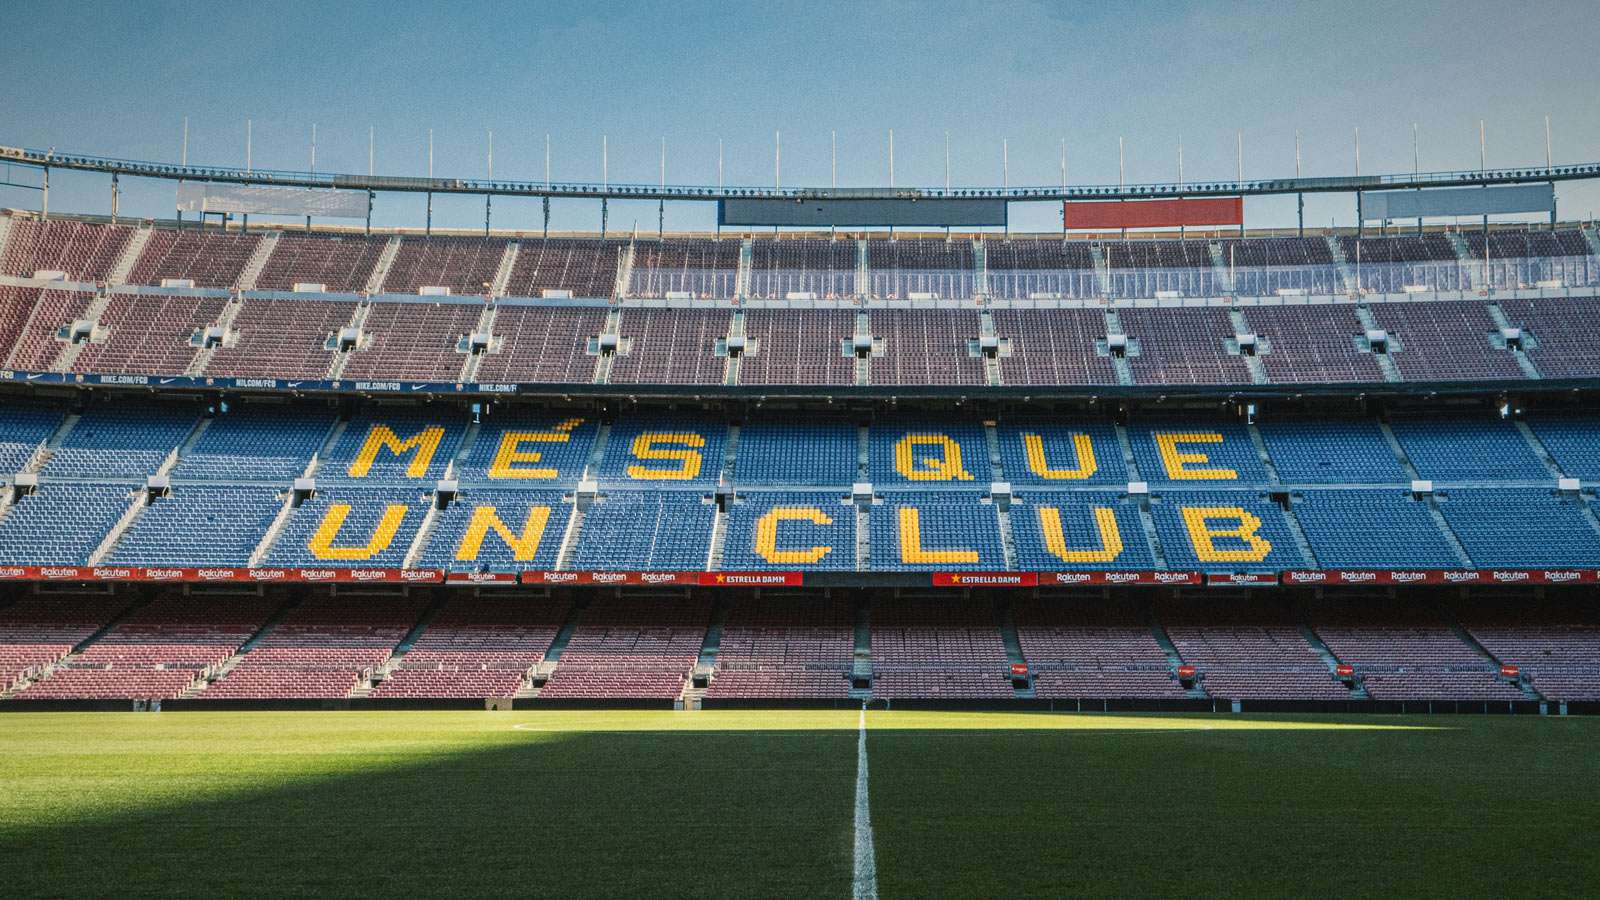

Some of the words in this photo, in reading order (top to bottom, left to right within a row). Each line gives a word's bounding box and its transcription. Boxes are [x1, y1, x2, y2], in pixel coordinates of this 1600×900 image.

[100, 375, 148, 384] NIKE.COM/FCB
[355, 382, 401, 391] NIKE.COM/FCB
[896, 431, 1238, 480] QUE
[307, 504, 552, 562] UN
[755, 506, 1272, 564] CLUB
[41, 568, 77, 576] Rakuten
[93, 568, 129, 577] Rakuten
[146, 569, 182, 578] Rakuten
[198, 569, 233, 578] Rakuten
[249, 570, 284, 578] Rakuten
[301, 570, 336, 578] Rakuten
[351, 570, 386, 578] Rakuten
[401, 570, 435, 579] Rakuten
[1154, 572, 1188, 581] Rakuten
[1291, 572, 1326, 580] Rakuten
[1341, 571, 1376, 580] Rakuten
[1391, 571, 1426, 580] Rakuten
[1443, 571, 1479, 580] Rakuten
[1493, 571, 1529, 580] Rakuten
[1544, 571, 1580, 579] Rakuten
[592, 573, 627, 581] Rakuten
[641, 573, 676, 581] Rakuten
[1056, 573, 1090, 581] Rakuten
[1105, 573, 1139, 581] Rakuten
